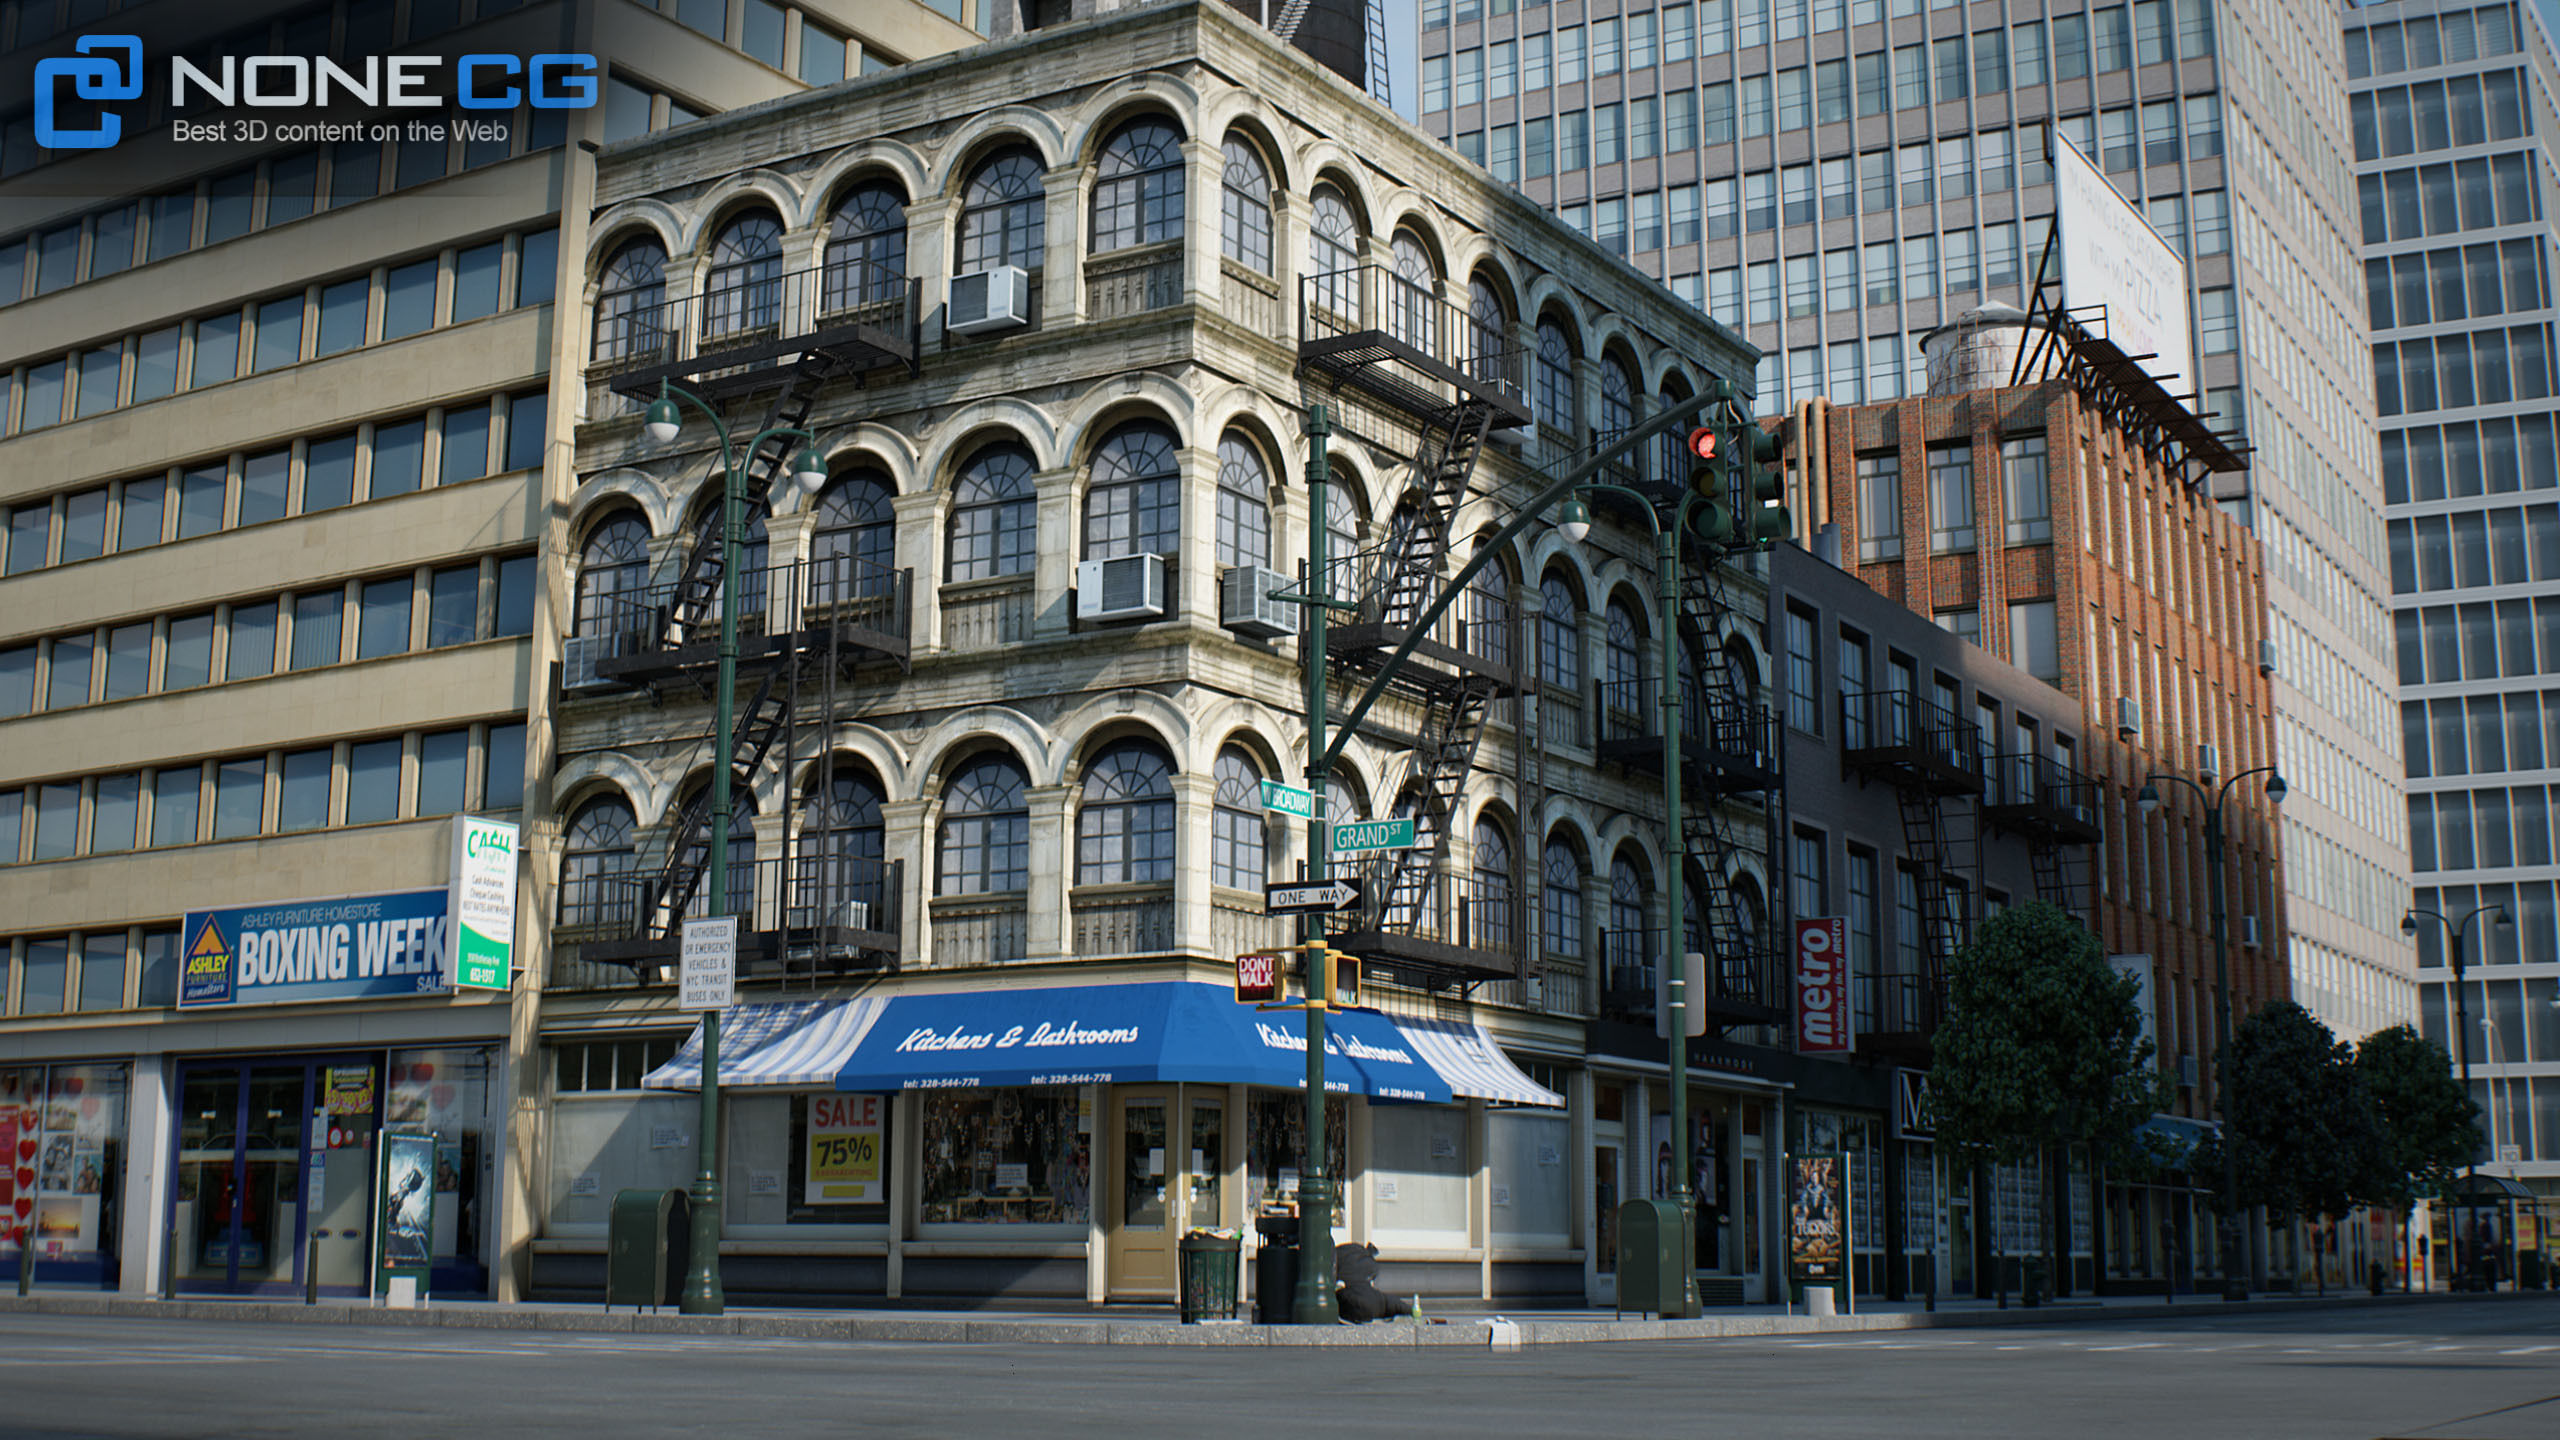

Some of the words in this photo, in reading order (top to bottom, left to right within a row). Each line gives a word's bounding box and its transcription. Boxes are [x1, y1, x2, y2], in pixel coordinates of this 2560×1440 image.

[1273, 788, 1311, 814] BROADWAY
[1336, 825, 1389, 848] GRAND
[1390, 823, 1403, 836] ST
[1278, 890, 1306, 905] ONE
[1319, 888, 1348, 902] WAY
[241, 911, 274, 928] ASHLEY
[275, 906, 325, 927] FURNITURE
[326, 902, 382, 921] HOMESTORE
[690, 925, 728, 938] AUTHORIZED
[237, 922, 350, 986] BOXING
[357, 915, 448, 978] WEEK
[685, 943, 693, 955] OR
[695, 941, 730, 954] EMERGENCY
[186, 954, 230, 975] ASHLEY
[688, 958, 718, 970] VEHICLES
[721, 957, 727, 969] &
[1239, 957, 1274, 972] DONT
[186, 972, 228, 986] FURNITURE
[416, 975, 446, 992] SALE
[686, 975, 699, 986] NYC
[702, 973, 728, 985] TRANSIT
[1239, 971, 1275, 987] WALK
[1798, 928, 1833, 1046] metro
[687, 991, 707, 1002] BUSES
[709, 990, 725, 1001] ONLY
[896, 1025, 994, 1053] Kitchens
[995, 1026, 1024, 1048] &
[1024, 1020, 1139, 1048] Bathrooms
[1332, 1032, 1414, 1064] Bathrooms
[903, 1079, 918, 1089] tel:
[920, 1077, 980, 1089] 328-544-778
[1030, 1074, 1047, 1085] tel:
[1048, 1073, 1112, 1084] 328-544-778
[815, 1097, 877, 1128] SALE
[816, 1136, 872, 1167] 75%
